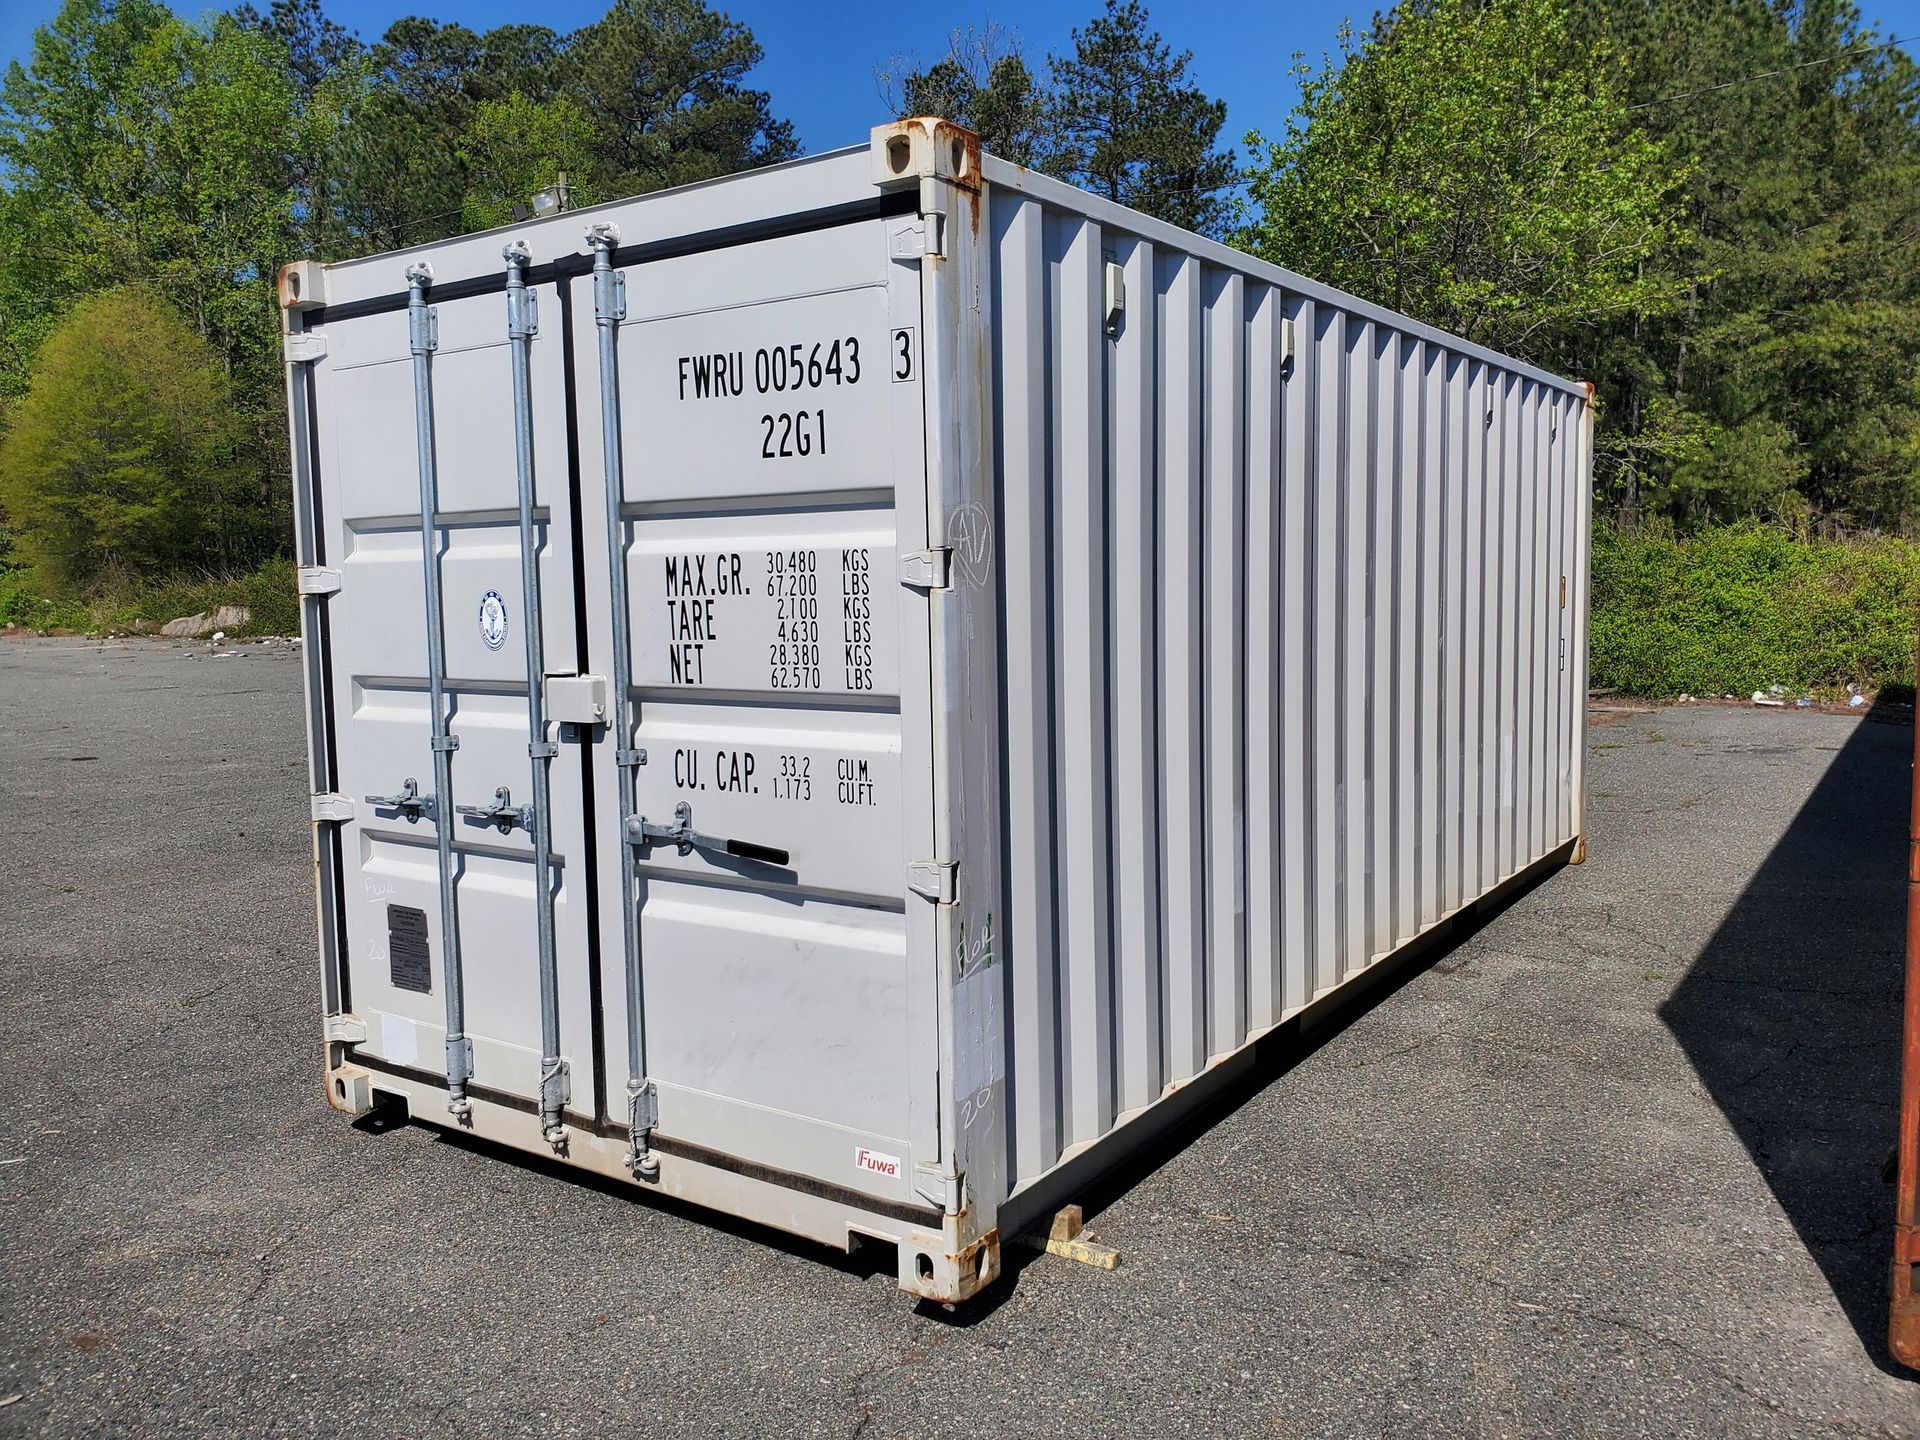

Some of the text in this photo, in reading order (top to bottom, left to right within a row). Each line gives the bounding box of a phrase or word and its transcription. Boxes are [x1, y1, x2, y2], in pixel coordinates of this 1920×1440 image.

[678, 330, 911, 400] FWRU 005643 3
[760, 409, 826, 459] 22G1
[665, 549, 869, 597] MAX.GR. 30,480 KGS
[767, 573, 870, 597] 67,200 LBS
[667, 597, 871, 641] TARE 2,100 KGS
[844, 620, 871, 643] LBS
[669, 643, 704, 685] NET
[845, 643, 872, 667] KGS
[846, 667, 873, 690] LBS
[674, 748, 873, 794] CU. CAP. 33.2 CU.M.
[838, 781, 877, 807] CU.FT.
[960, 1087, 991, 1131] 20
[857, 1149, 896, 1176] Fuwa
